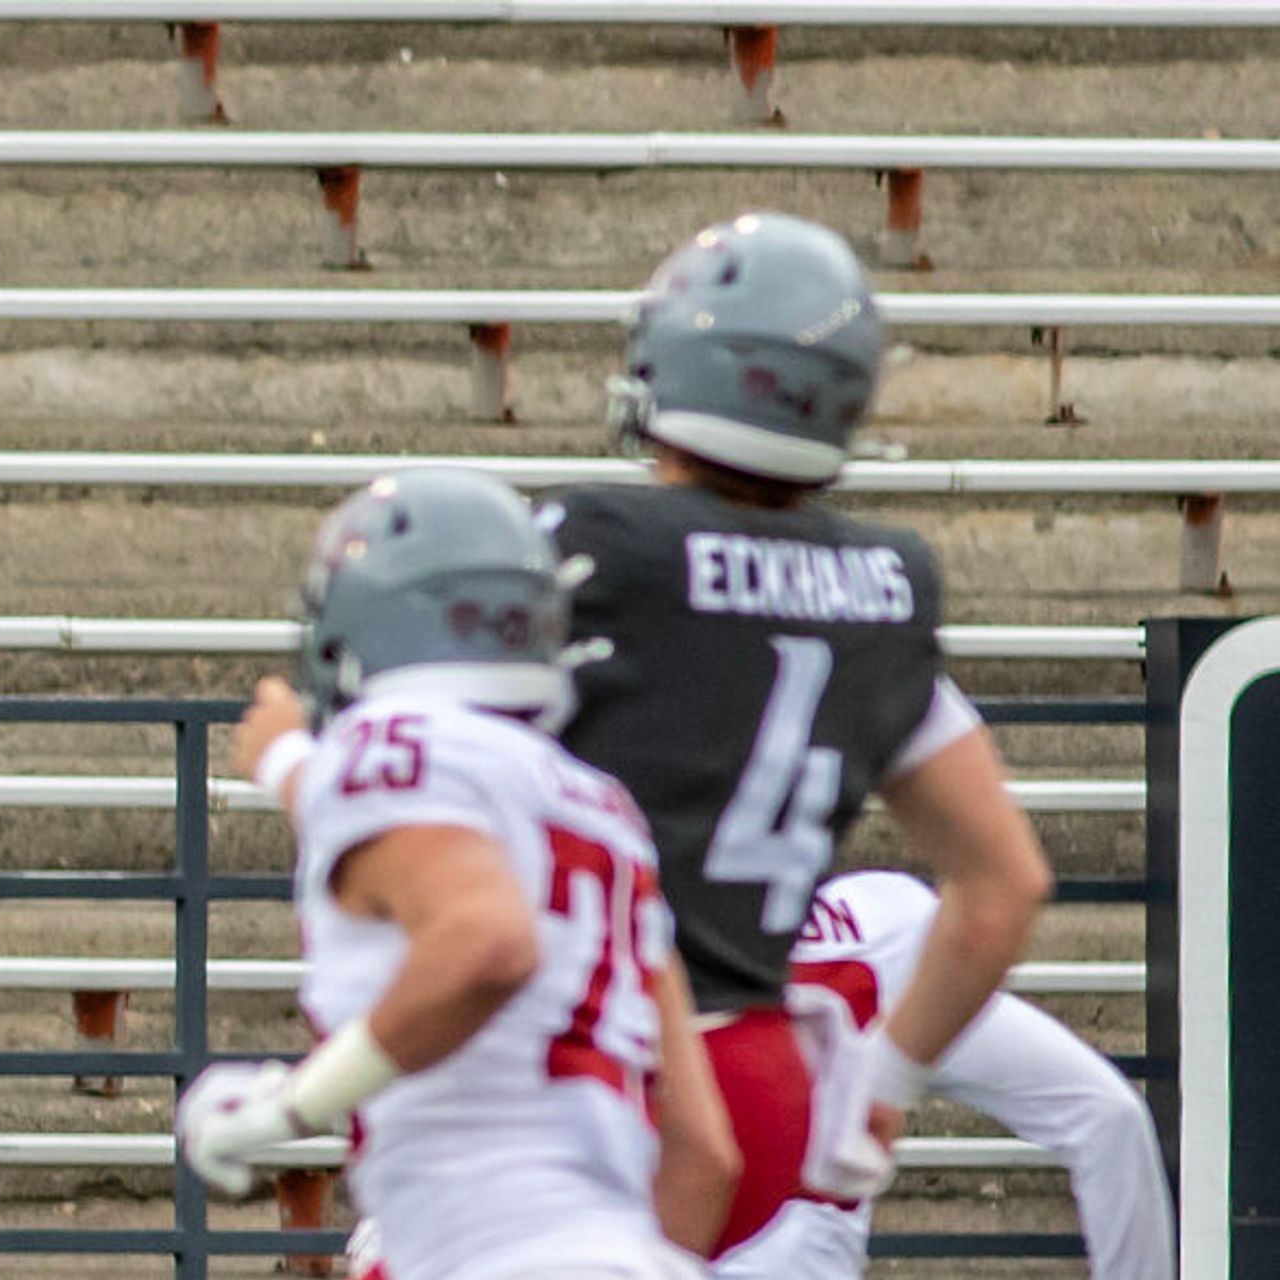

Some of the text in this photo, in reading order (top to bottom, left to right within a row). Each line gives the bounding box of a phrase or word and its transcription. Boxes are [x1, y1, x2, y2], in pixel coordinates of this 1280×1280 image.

[685, 532, 914, 622] ECKHAUS
[341, 714, 425, 796] 25
[702, 634, 843, 934] 4
